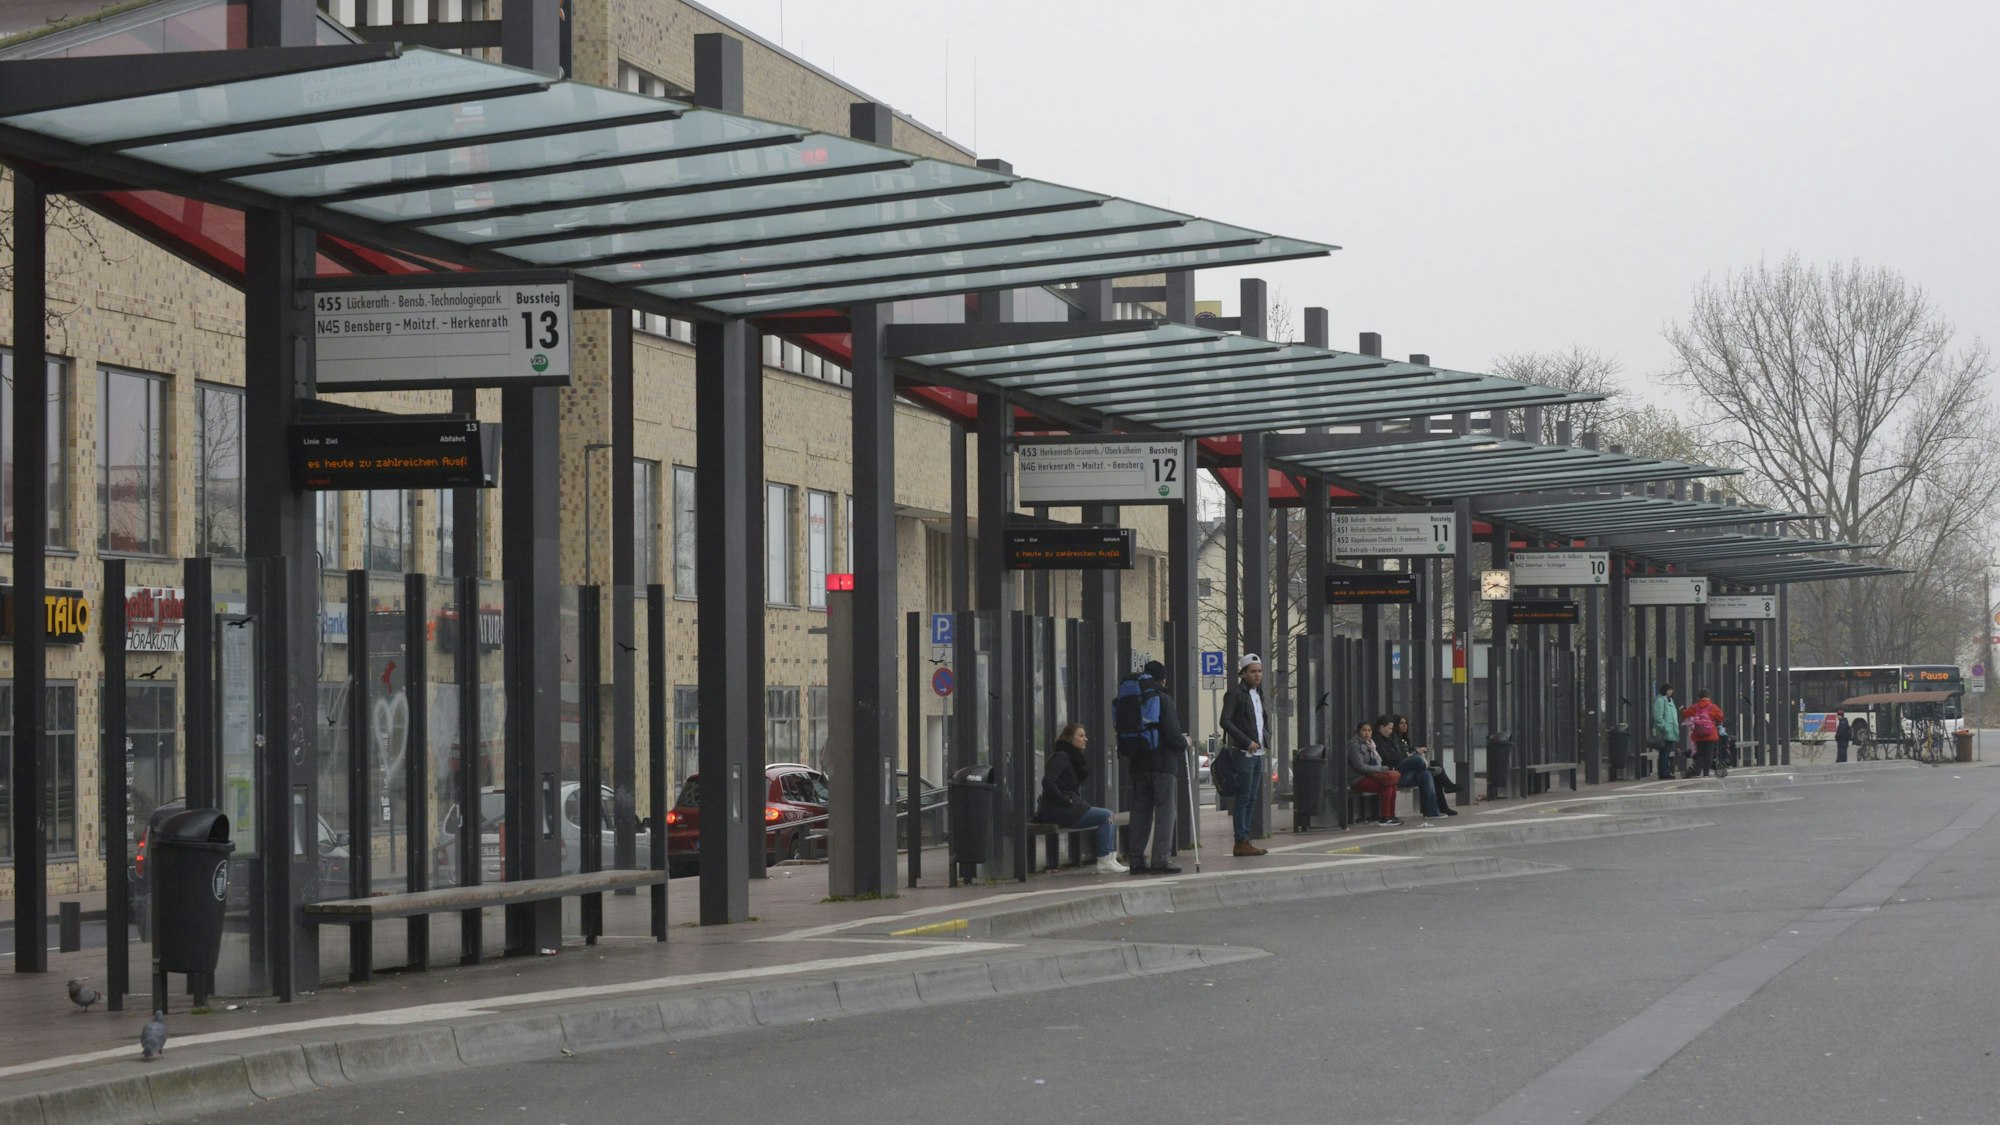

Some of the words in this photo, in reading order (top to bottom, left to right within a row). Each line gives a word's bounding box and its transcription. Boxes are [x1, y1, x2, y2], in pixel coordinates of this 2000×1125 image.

[317, 296, 342, 312] 455
[346, 297, 390, 311] Lückerath
[398, 292, 502, 309] Bensb.-Technologiepark
[516, 291, 560, 308] Bussteig
[317, 319, 340, 335] N45
[344, 317, 392, 334] Bensberg
[403, 315, 440, 331] Moitzf.
[450, 315, 509, 331] Herkenrath
[521, 310, 560, 350] 13
[530, 356, 545, 366] VRS
[465, 423, 478, 433] 13
[303, 437, 320, 446] Linie
[325, 437, 338, 446] Ziel
[440, 434, 466, 444] Abfahrt
[1021, 448, 1037, 457] 453
[1149, 446, 1178, 456] Bussteig
[308, 460, 320, 469] es
[324, 458, 355, 469] heute
[359, 459, 371, 469] zu
[376, 457, 438, 468] zahlreichen
[1021, 462, 1035, 472] N46
[1038, 462, 1075, 472] Herkenrath
[1082, 461, 1106, 470] Moitzf.
[1112, 460, 1144, 471] Bensberg
[1152, 458, 1177, 482] 12
[1433, 524, 1449, 542] 11
[1591, 561, 1605, 575] 10
[1694, 584, 1701, 596] 9
[1764, 602, 1770, 612] 8
[937, 618, 950, 641] P
[1206, 654, 1218, 673] P
[1920, 671, 1950, 680] Pause
